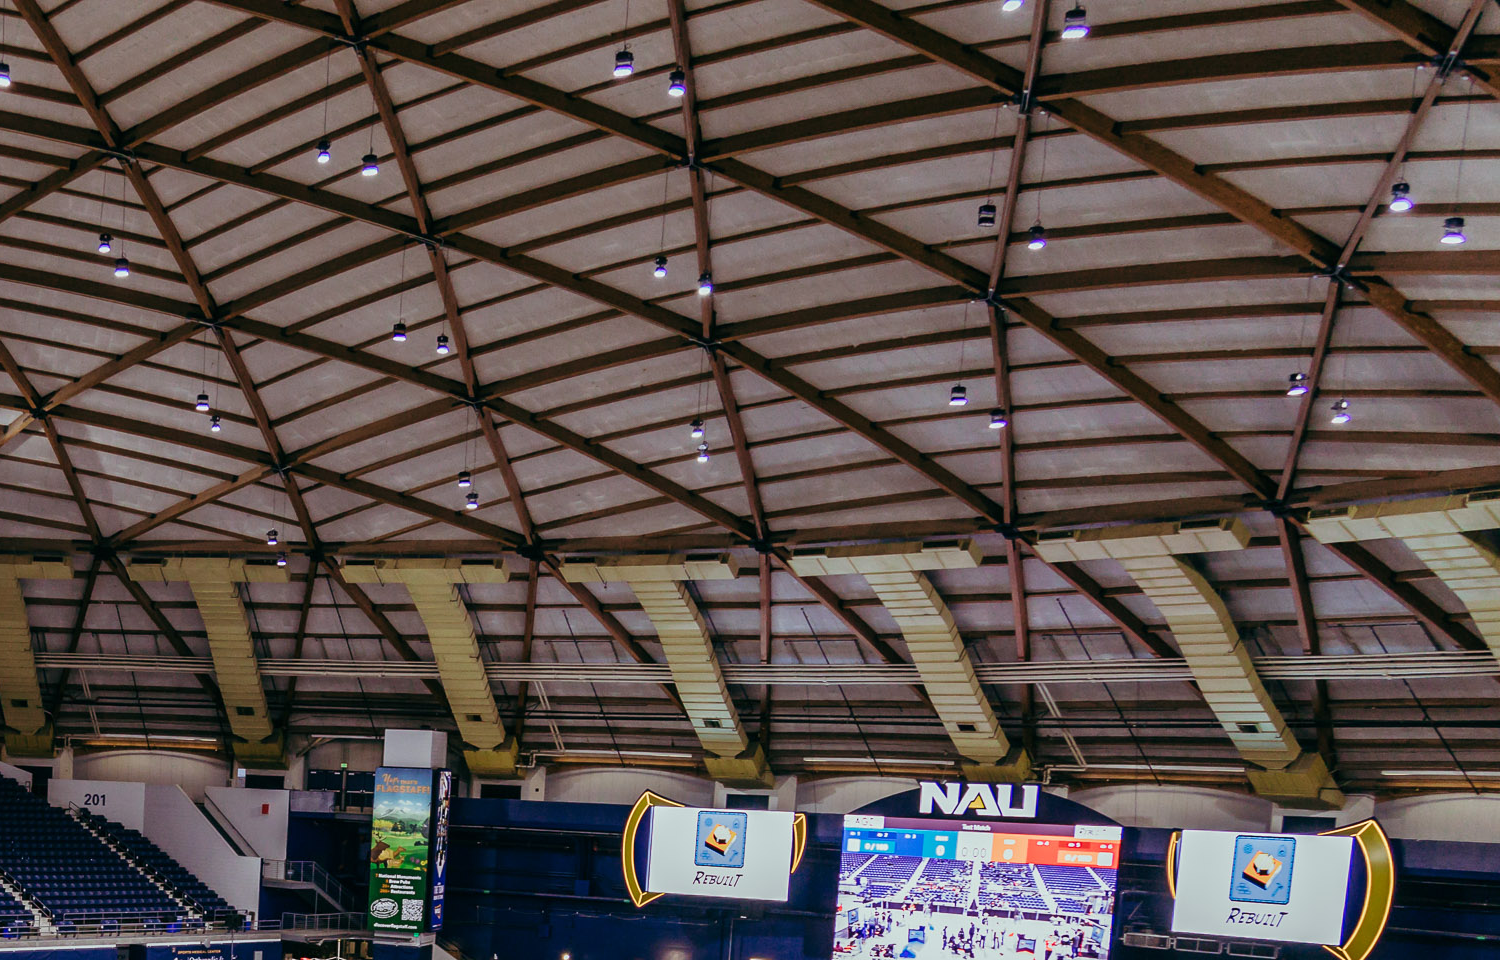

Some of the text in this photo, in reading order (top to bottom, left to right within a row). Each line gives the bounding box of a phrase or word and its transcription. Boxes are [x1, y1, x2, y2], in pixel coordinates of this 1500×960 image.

[376, 784, 430, 794] FLAGSTAFF!
[84, 794, 106, 806] 201
[919, 782, 1039, 818] NAU
[692, 871, 743, 887] REBUILT
[1226, 907, 1289, 928] REBUILT
